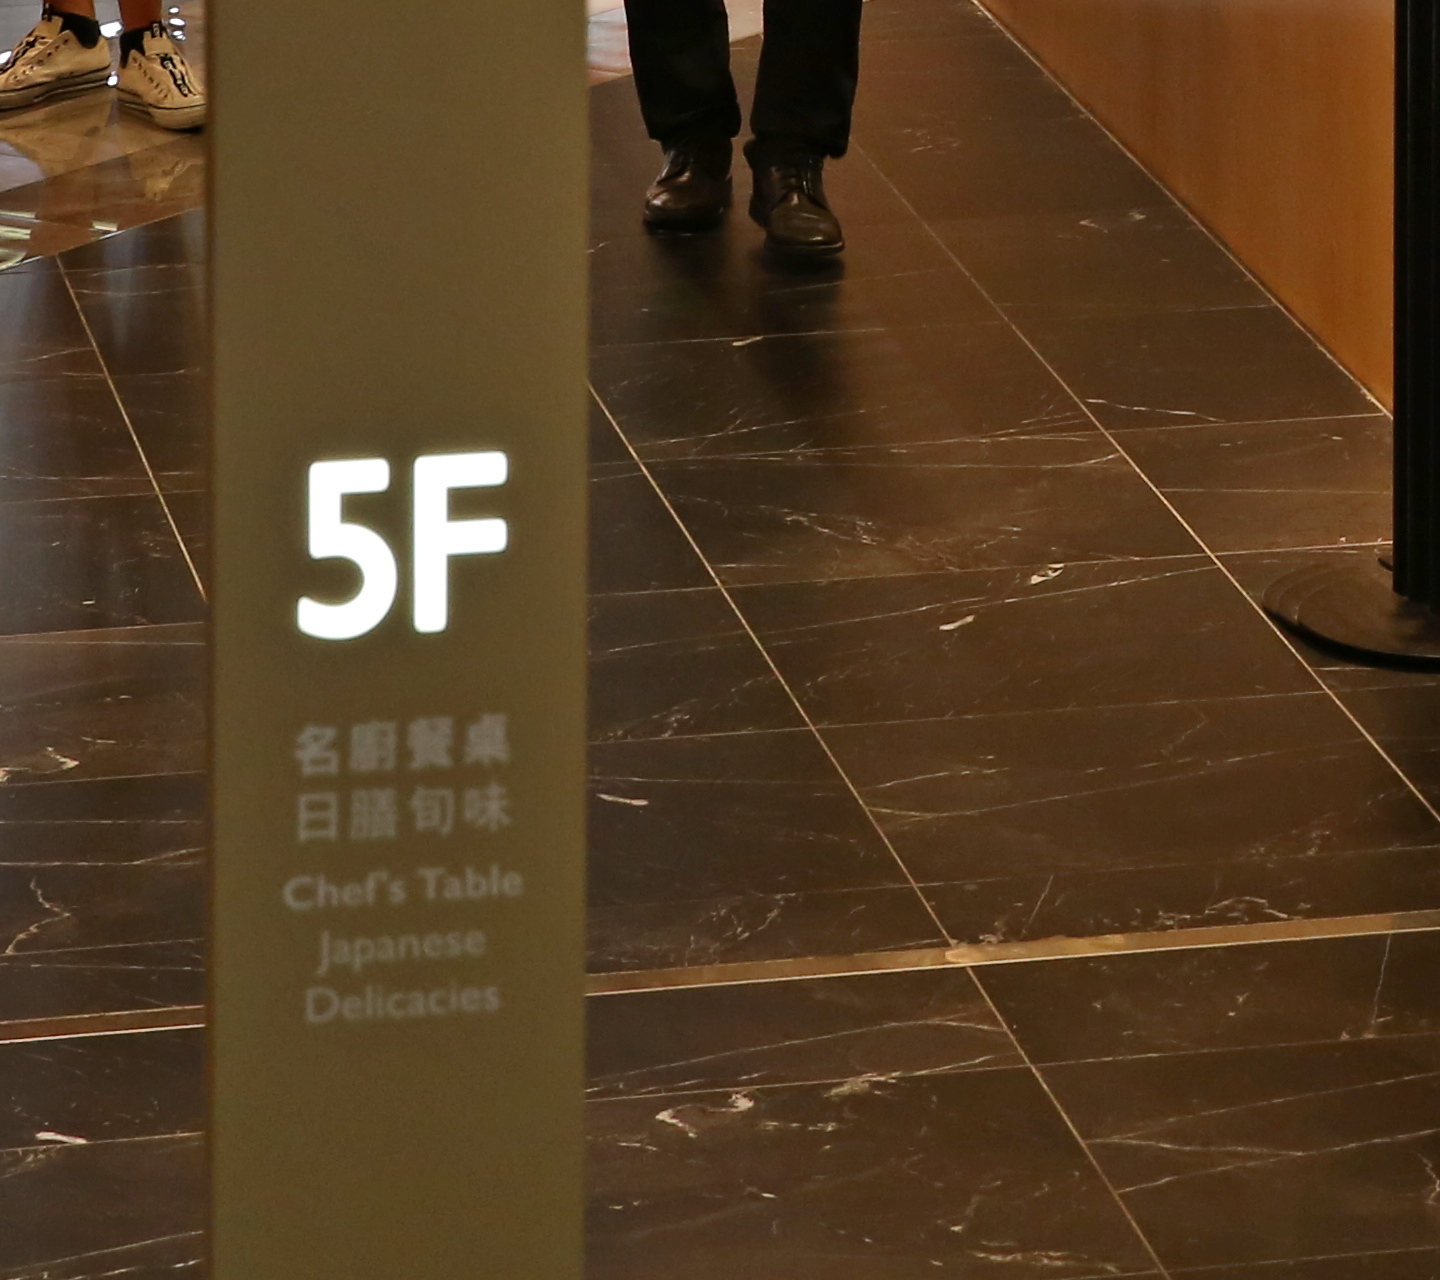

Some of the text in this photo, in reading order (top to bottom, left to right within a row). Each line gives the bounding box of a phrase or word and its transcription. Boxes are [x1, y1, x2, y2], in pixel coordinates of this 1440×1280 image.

[296, 450, 509, 641] 5F
[294, 713, 511, 777] 名廚餐桌
[282, 863, 525, 911] Chef's Table
[316, 929, 488, 977] Japanese
[305, 980, 502, 1024] Delicacies
